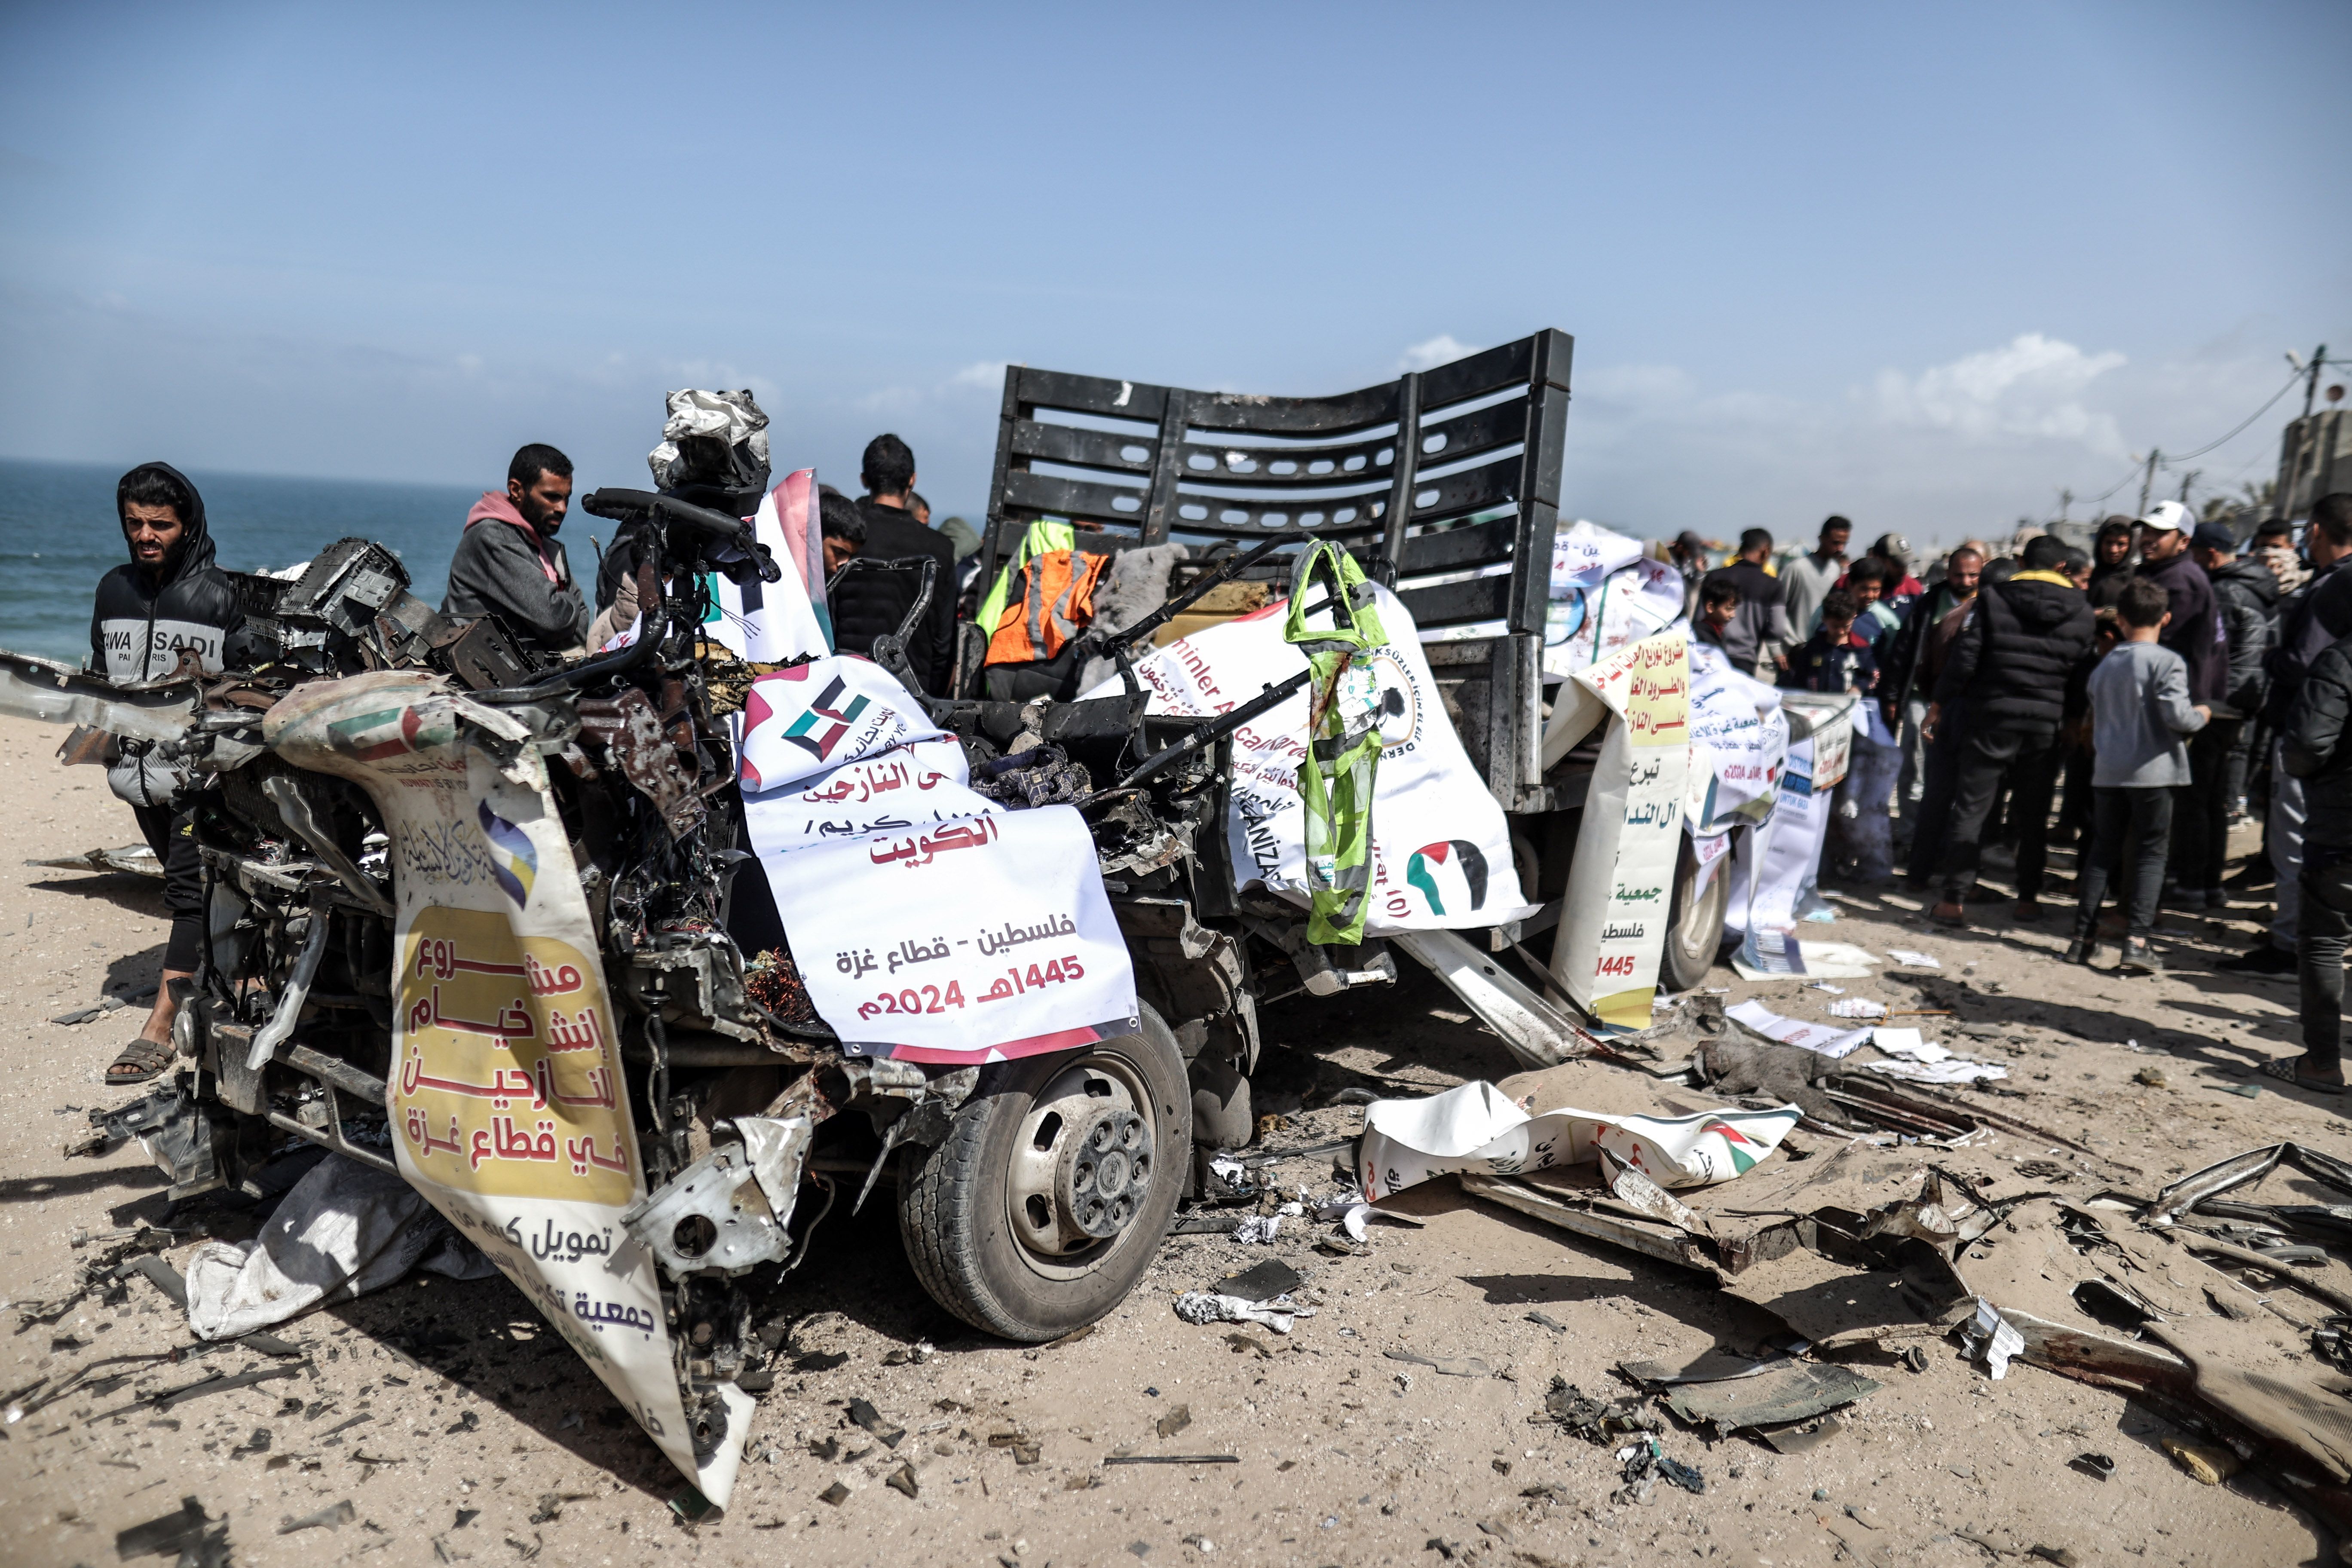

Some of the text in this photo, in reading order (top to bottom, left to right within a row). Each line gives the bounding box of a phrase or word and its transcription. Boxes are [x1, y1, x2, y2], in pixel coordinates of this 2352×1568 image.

[1375, 647, 1416, 683] KSÜZLER
[802, 760, 910, 803] النازحين
[870, 815, 998, 869] الكويت
[1615, 883, 1663, 906] جمعية
[977, 913, 1077, 956] فلسطين
[1601, 922, 1644, 943] فلسطي
[416, 937, 583, 997] مشروع
[836, 948, 879, 980] غزة
[887, 935, 951, 975] قطاع
[408, 984, 536, 1050] خيام
[857, 980, 965, 1021] 2024م
[406, 1106, 629, 1177] في قطاع غزة
[532, 1219, 613, 1262] تمويل
[573, 1291, 655, 1342] جمعية
